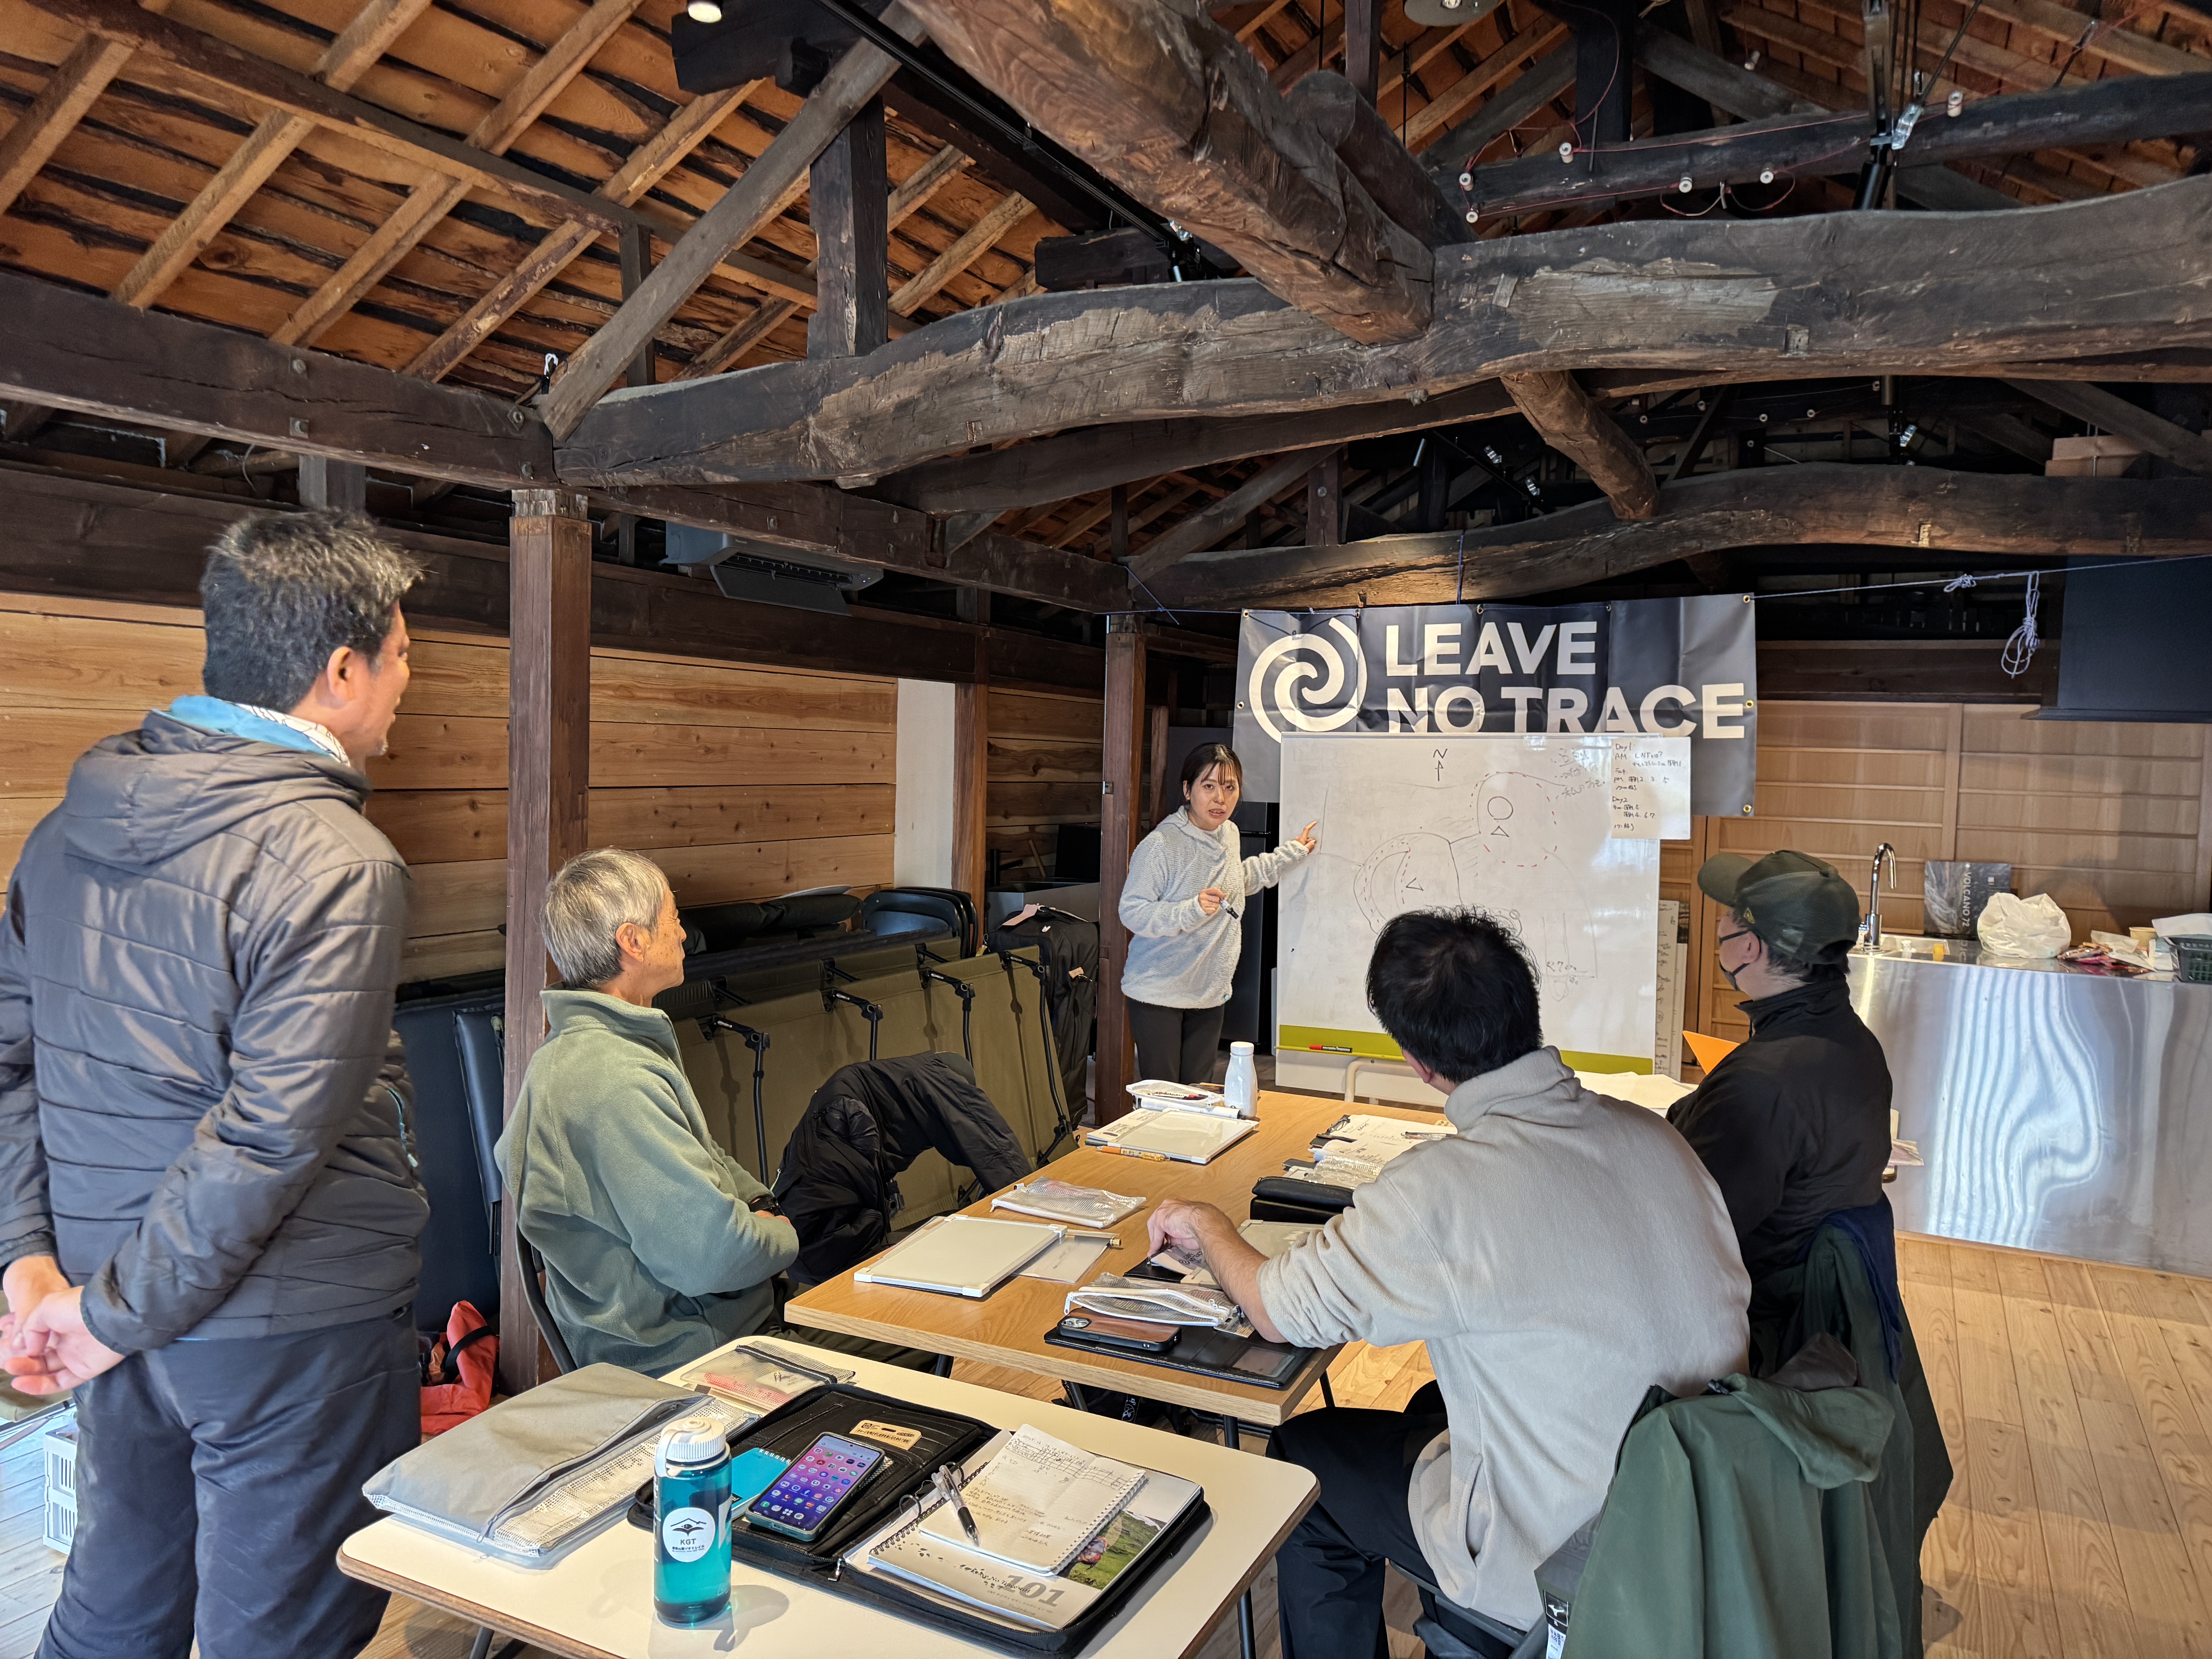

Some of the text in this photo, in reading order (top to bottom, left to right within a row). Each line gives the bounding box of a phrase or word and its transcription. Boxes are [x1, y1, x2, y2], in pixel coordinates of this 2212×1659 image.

[1386, 621, 1597, 676] LEAVE
[1387, 683, 1744, 738] NO TRACE
[1433, 748, 1448, 759] N
[1961, 872, 1972, 927] VOLCANO 72
[1001, 1575, 1065, 1607] 101
